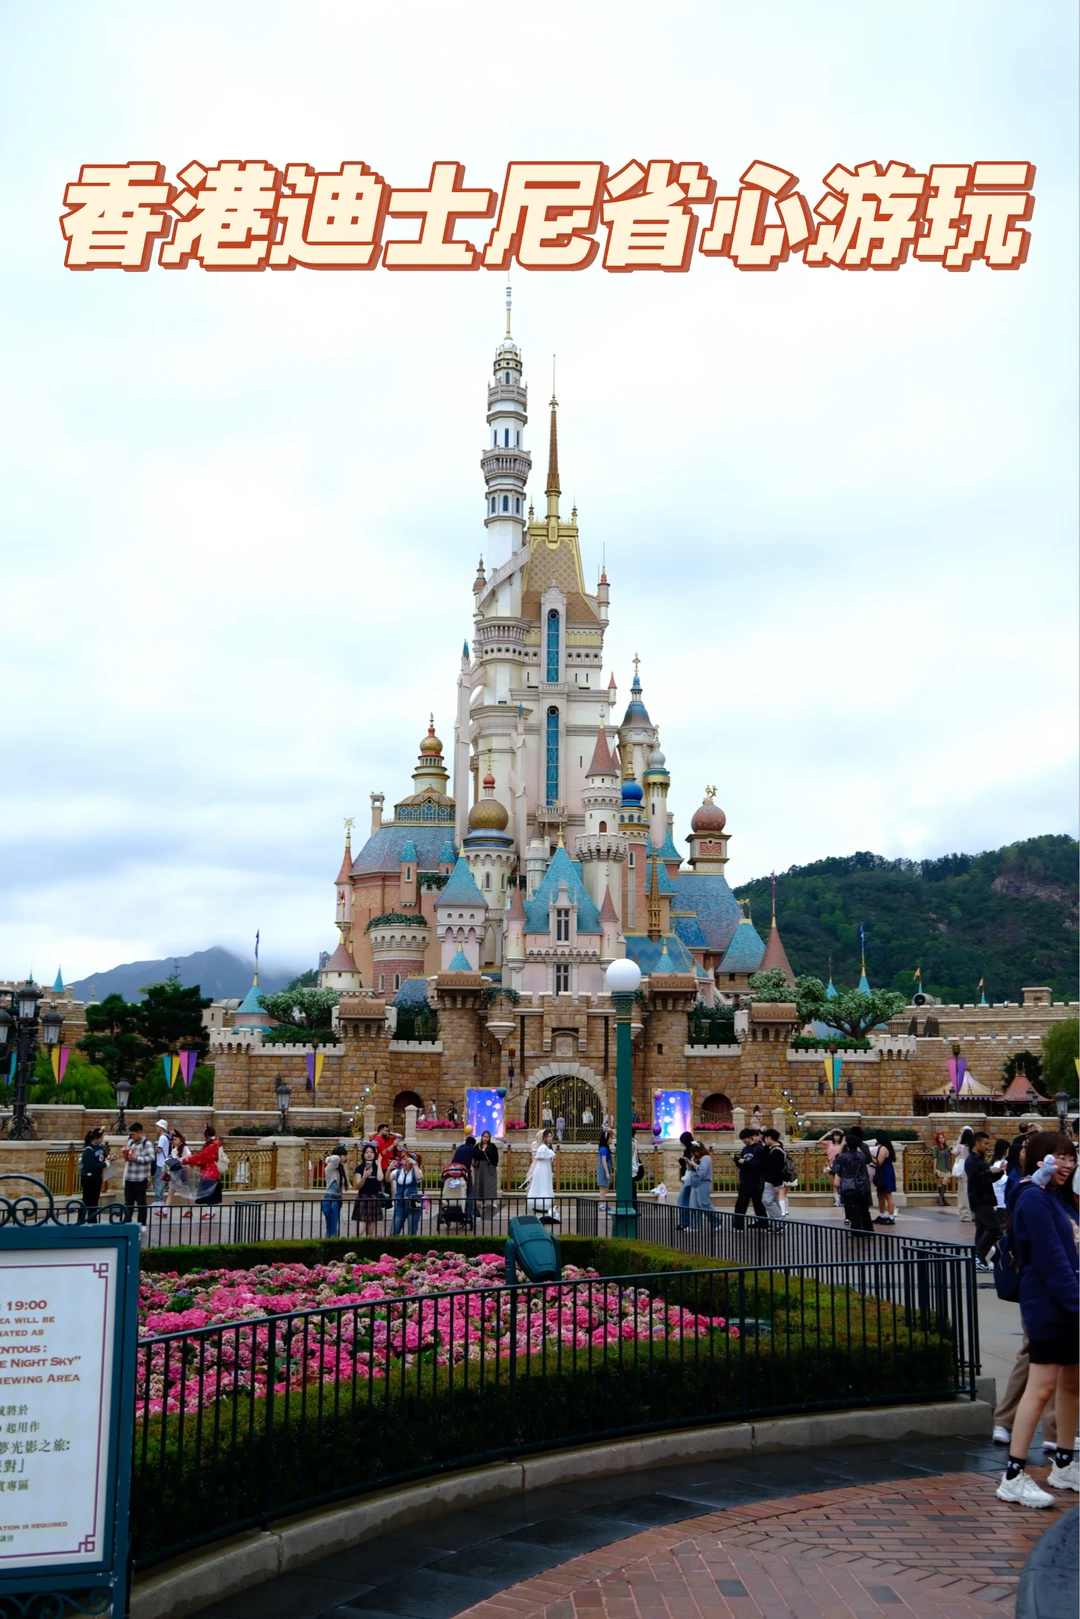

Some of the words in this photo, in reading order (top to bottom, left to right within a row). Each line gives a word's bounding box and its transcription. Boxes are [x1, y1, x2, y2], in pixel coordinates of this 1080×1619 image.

[7, 1300, 47, 1311] 19:00
[14, 1316, 39, 1324] WILL
[6, 1421, 40, 1434] 起用作
[0, 1458, 25, 1473] 對」
[31, 1521, 68, 1529] REQUIRED
